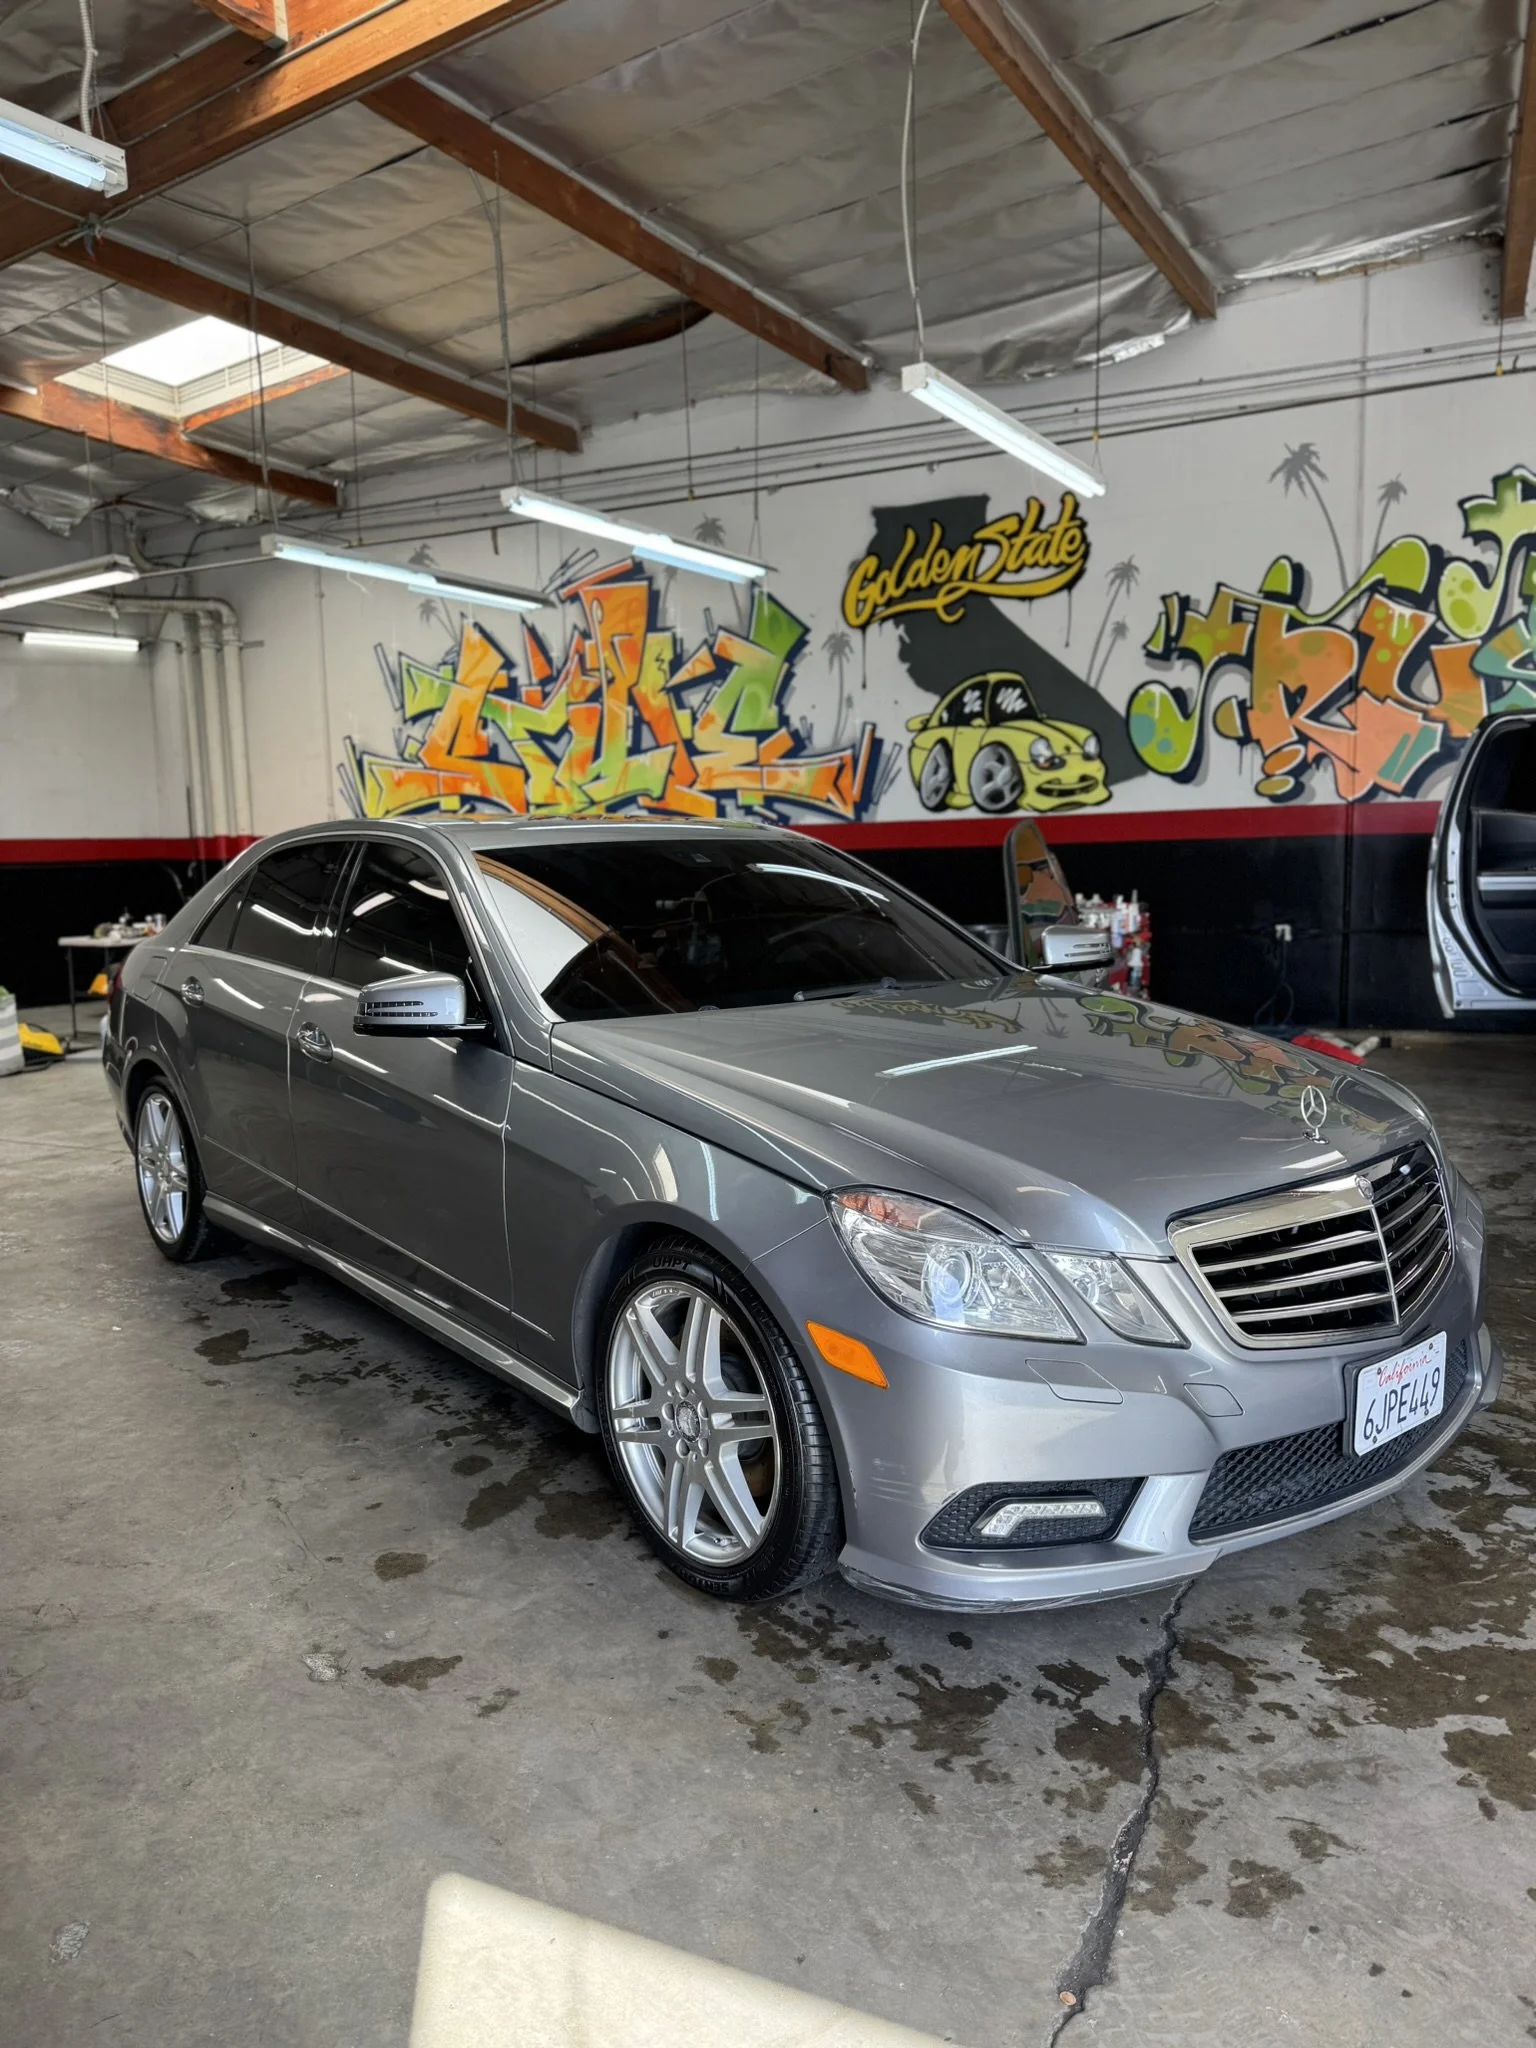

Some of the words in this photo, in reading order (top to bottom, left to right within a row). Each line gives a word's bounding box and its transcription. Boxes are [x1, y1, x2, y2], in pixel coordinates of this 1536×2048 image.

[842, 519, 984, 628] Golden
[973, 491, 1087, 584] State
[1363, 1367, 1440, 1440] 6JPE449
[1379, 1353, 1431, 1387] California
